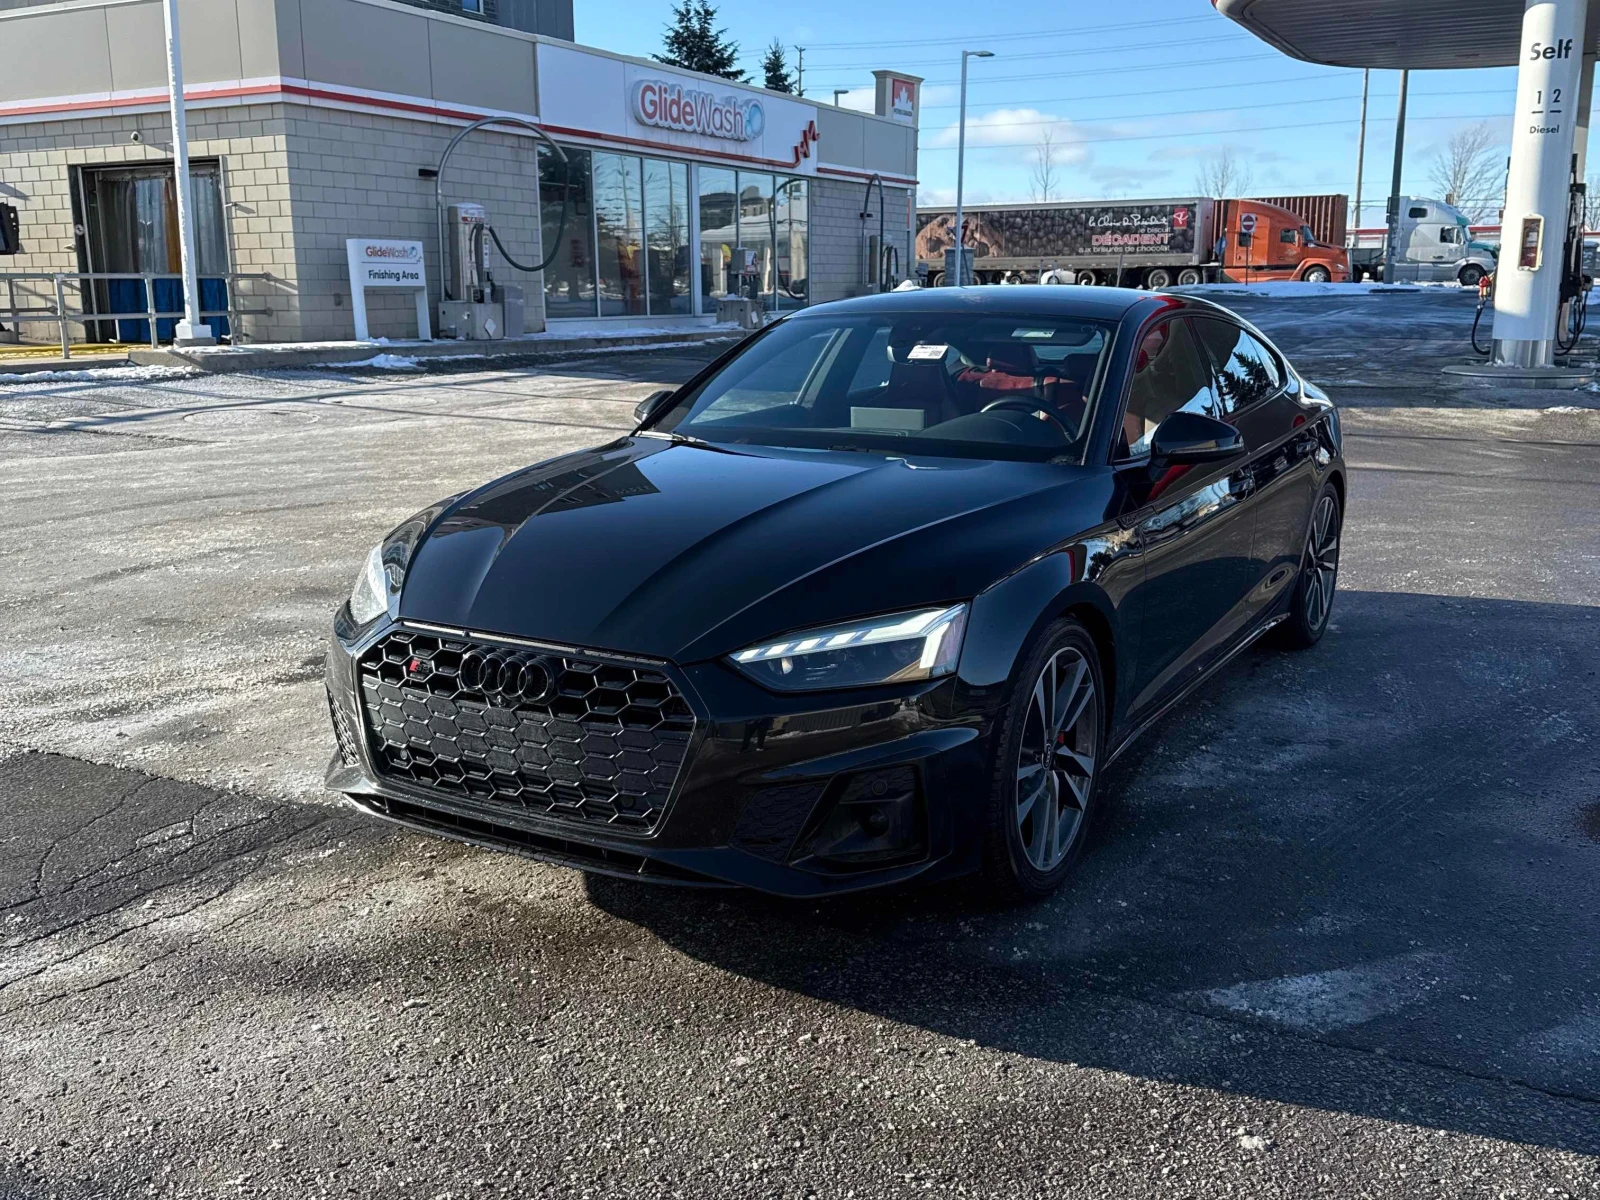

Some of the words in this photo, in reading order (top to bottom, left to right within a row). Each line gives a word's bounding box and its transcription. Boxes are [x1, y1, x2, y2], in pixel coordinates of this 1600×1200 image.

[1530, 39, 1573, 60] Self
[1537, 90, 1542, 105] 1
[1553, 88, 1562, 103] 2
[640, 84, 744, 136] GlideWash
[1529, 125, 1560, 134] Diesel
[1091, 230, 1169, 246] DÉCADENT
[365, 245, 408, 258] GlideWash
[1125, 245, 1135, 253] de
[1136, 244, 1171, 252] chocolat
[368, 269, 401, 282] Finishing
[401, 270, 419, 280] Area
